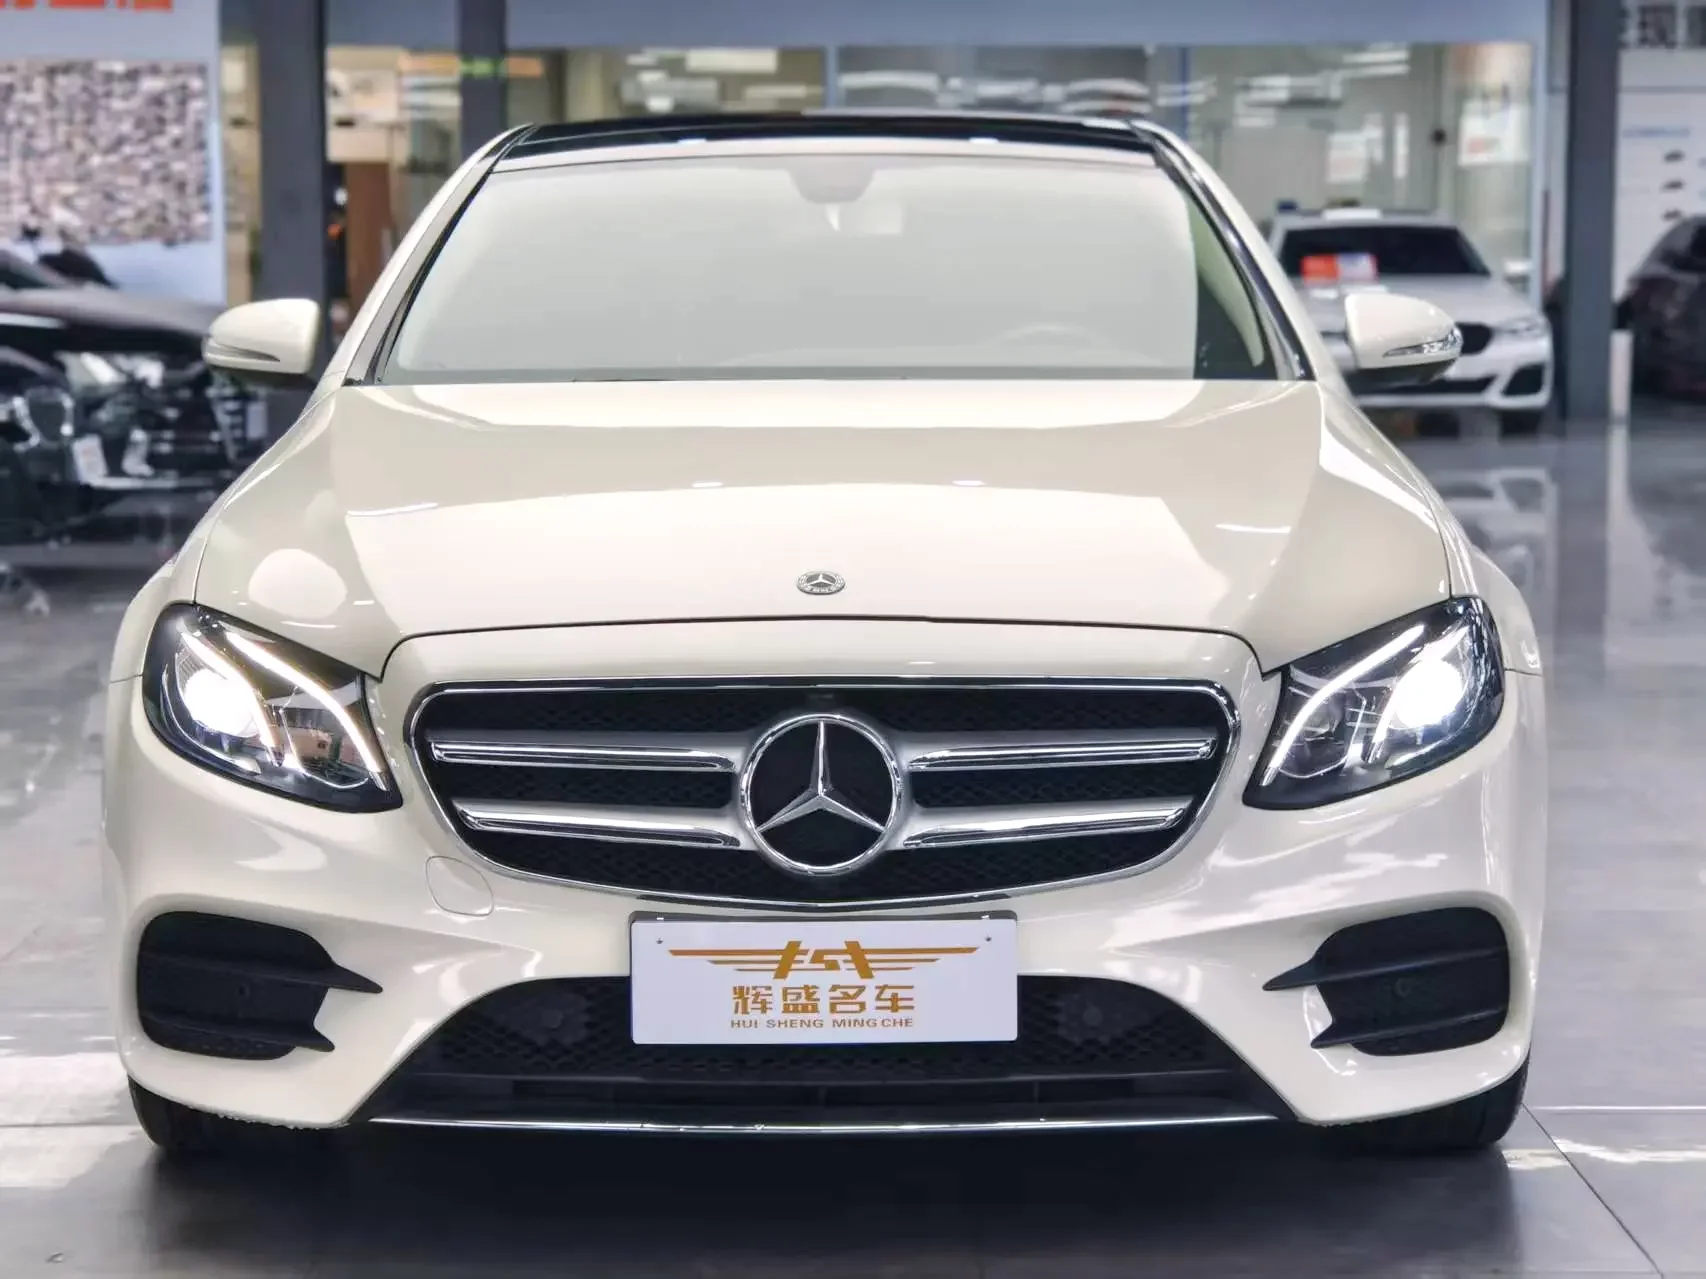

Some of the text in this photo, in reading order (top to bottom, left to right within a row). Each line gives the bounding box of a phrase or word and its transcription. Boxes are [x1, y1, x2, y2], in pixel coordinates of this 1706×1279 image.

[732, 984, 915, 1014] 辉盛名车
[730, 1018, 913, 1029] HUI SHENG MING CHE
